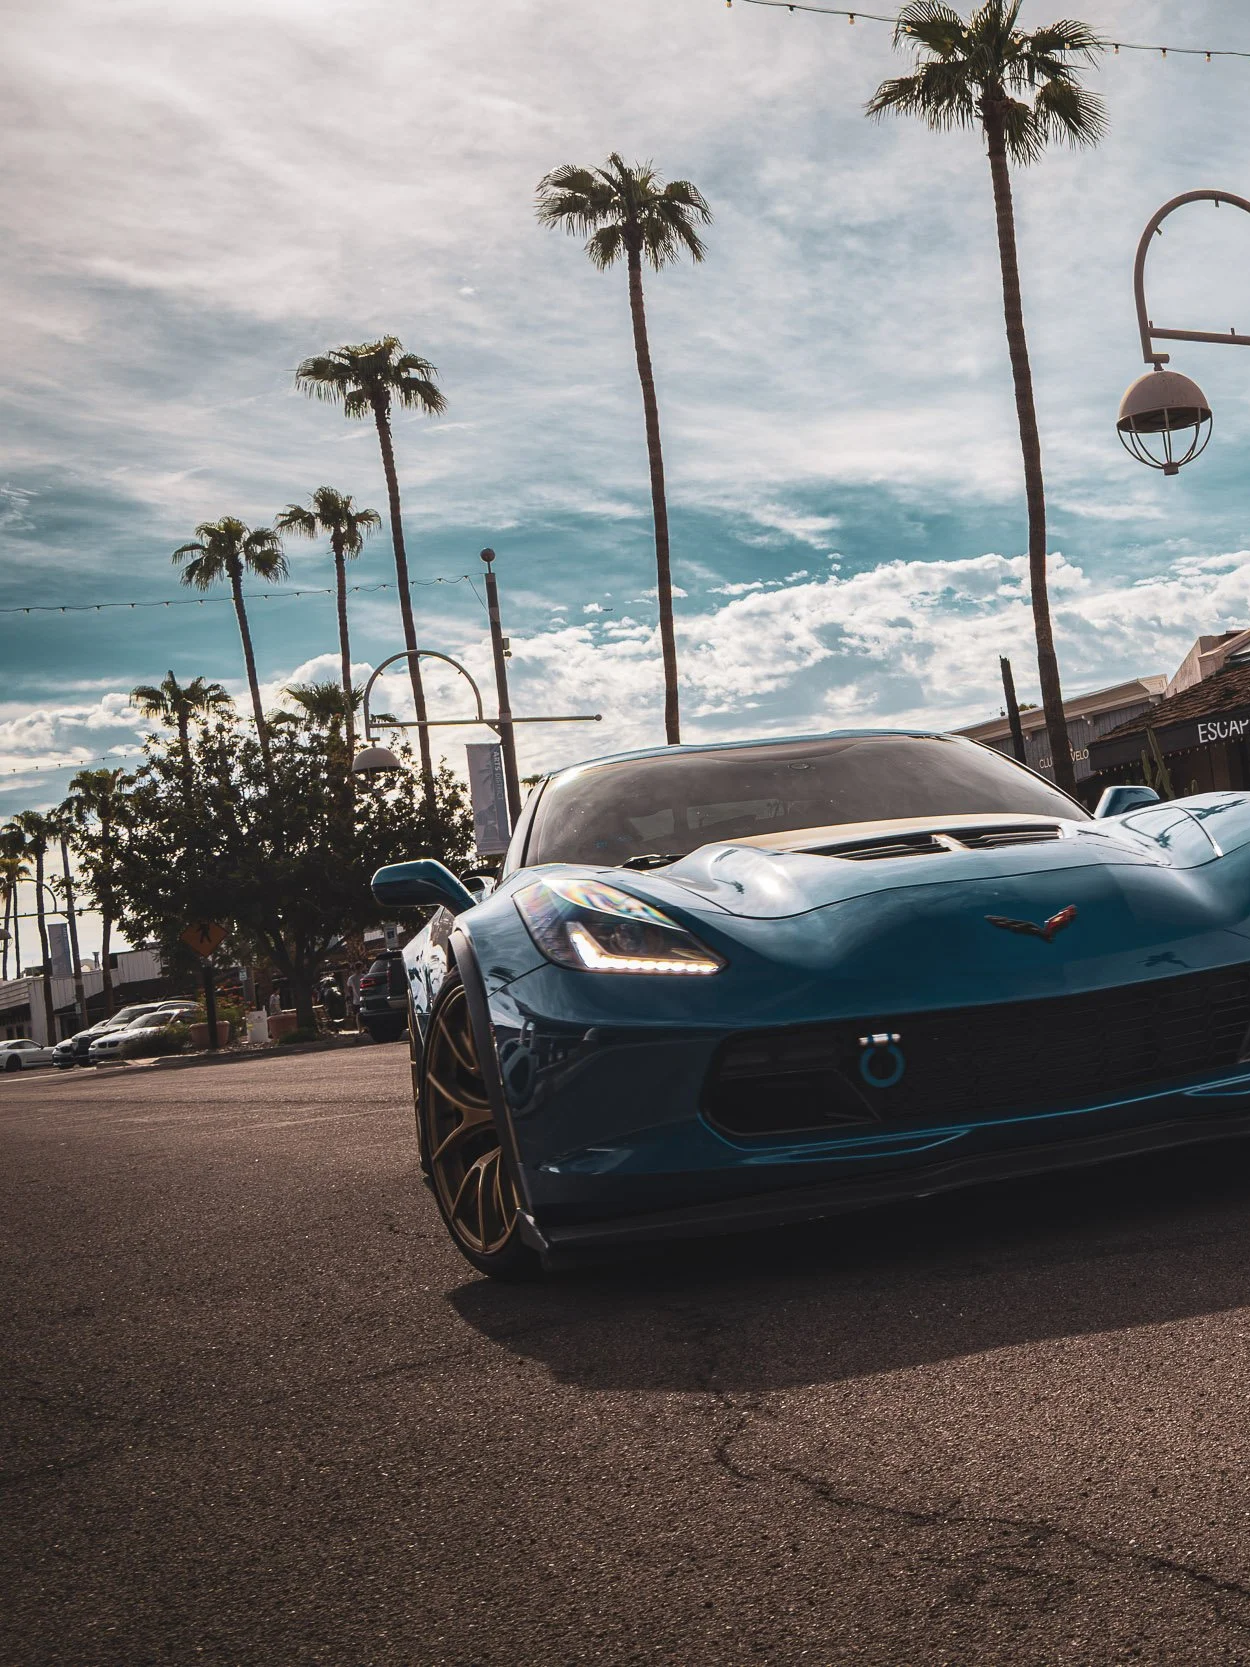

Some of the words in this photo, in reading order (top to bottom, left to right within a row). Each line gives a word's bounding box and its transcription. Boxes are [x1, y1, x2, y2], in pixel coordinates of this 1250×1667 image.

[493, 752, 501, 771] ARTS
[1039, 757, 1053, 769] CLU
[1070, 748, 1090, 762] VELO
